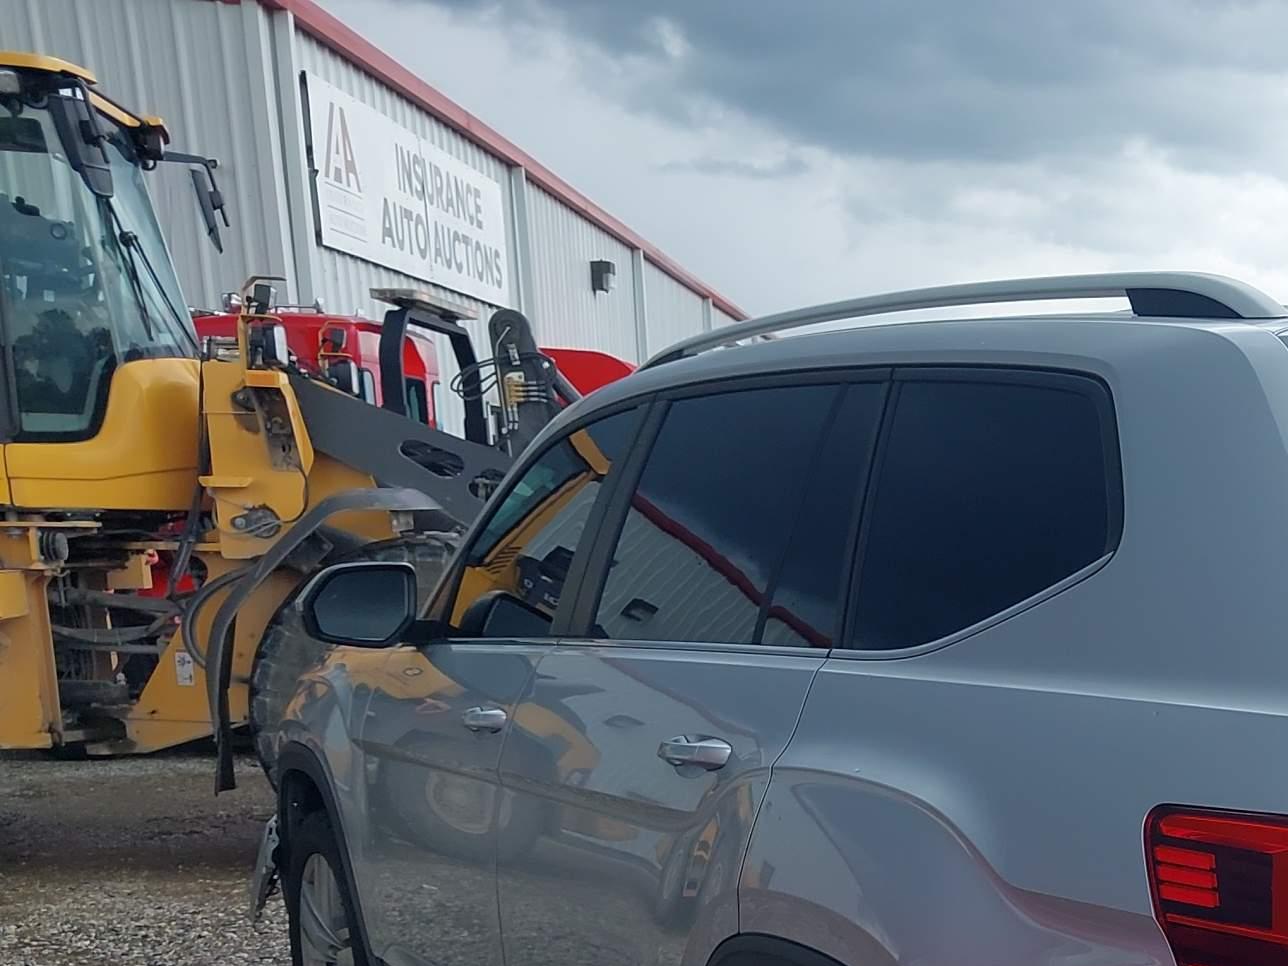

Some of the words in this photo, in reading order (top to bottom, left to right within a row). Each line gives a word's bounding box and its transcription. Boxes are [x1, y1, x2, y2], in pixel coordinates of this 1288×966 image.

[395, 142, 483, 230] INSURANCE
[381, 197, 427, 260] AUTO
[434, 221, 502, 289] AUCTIONS
